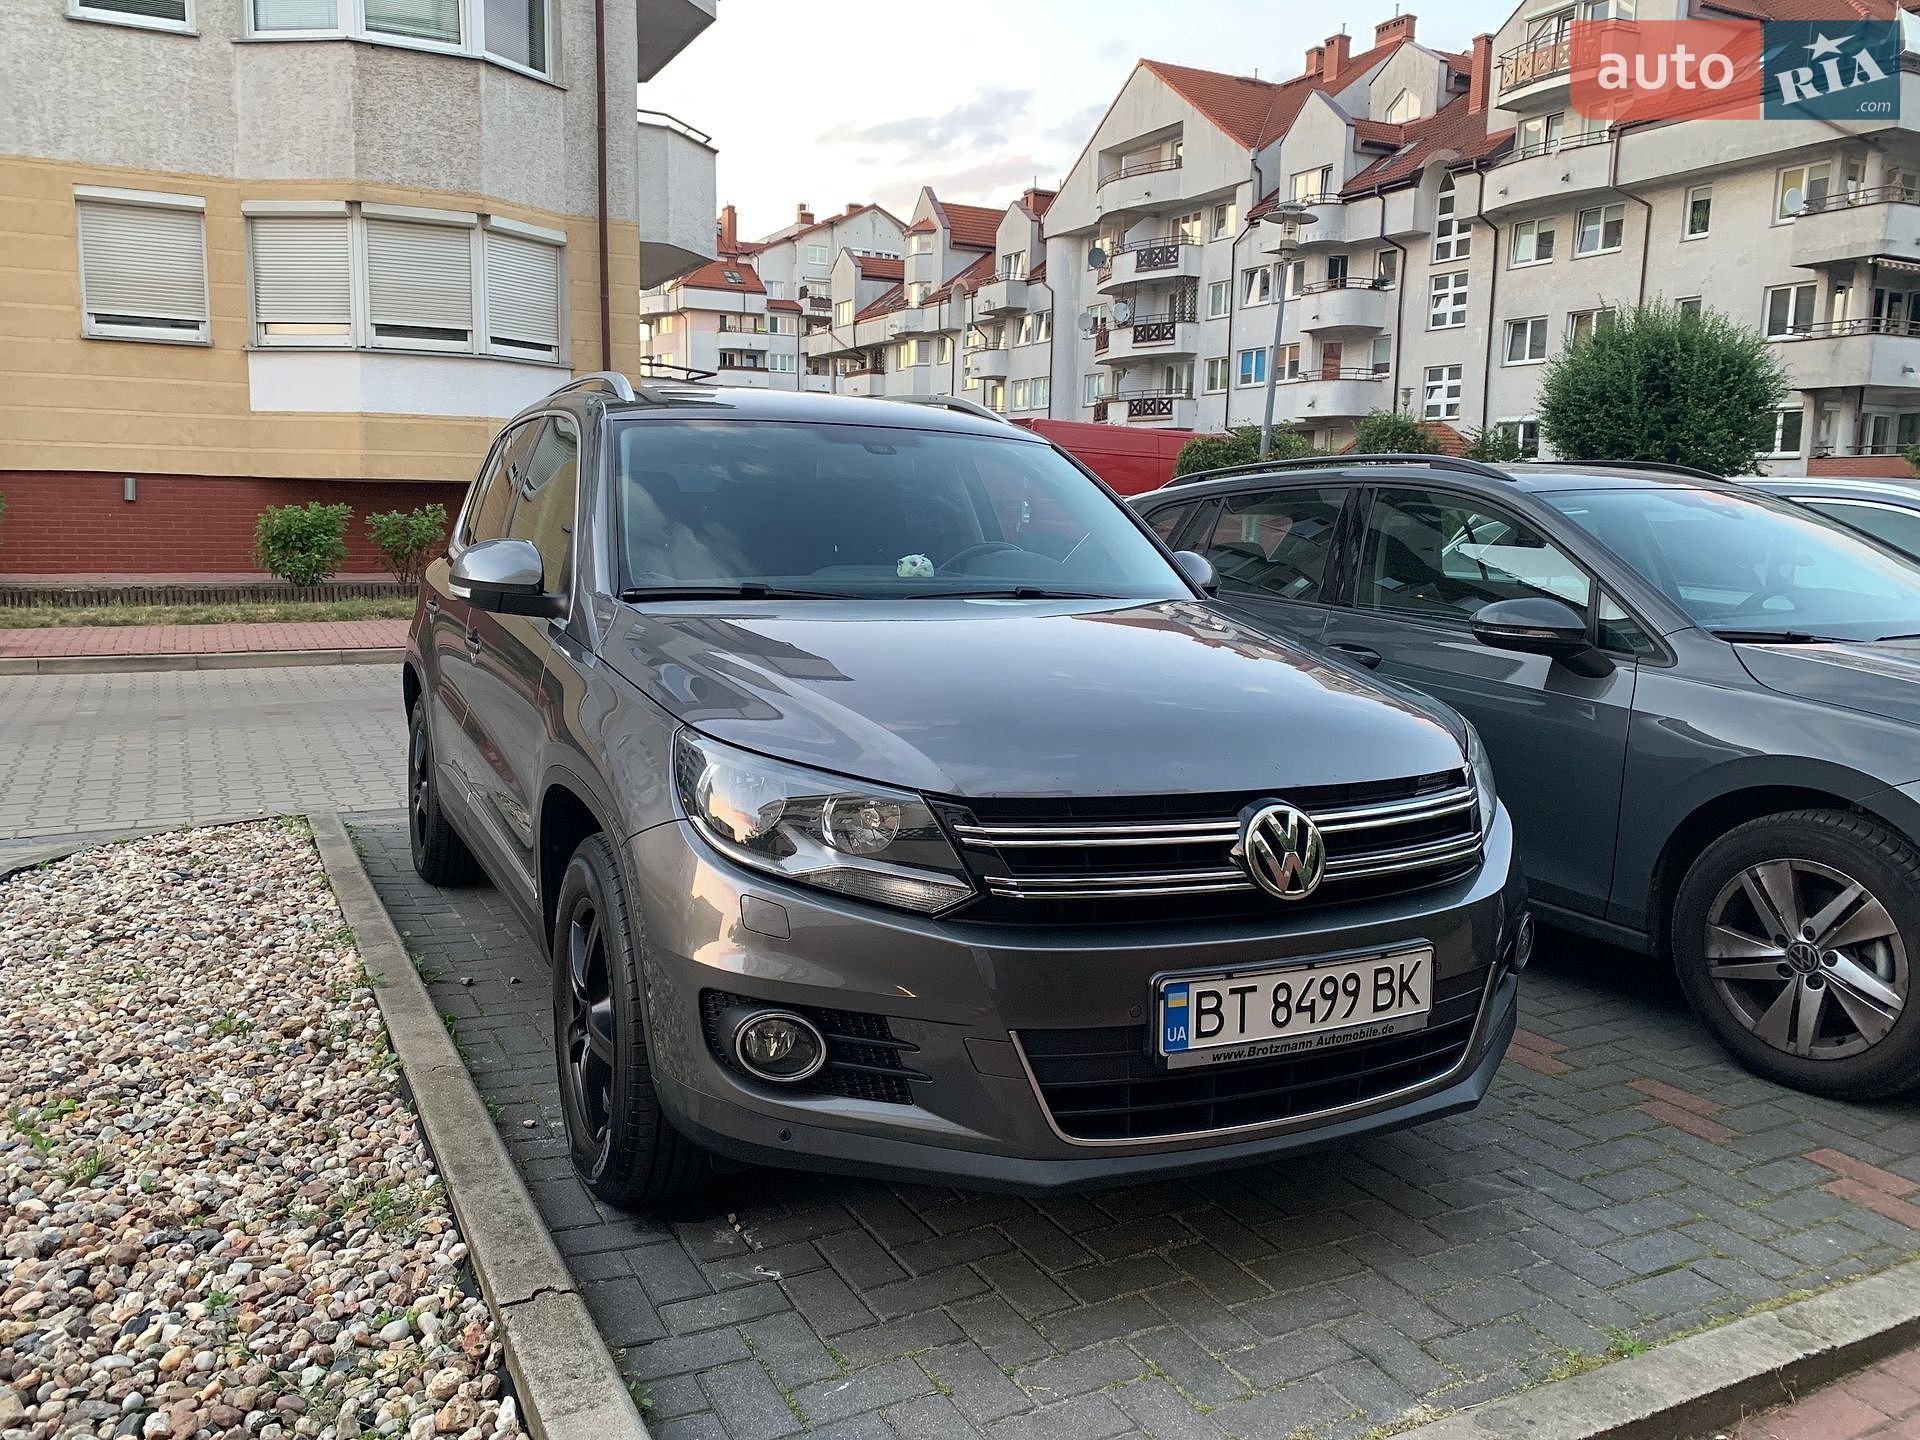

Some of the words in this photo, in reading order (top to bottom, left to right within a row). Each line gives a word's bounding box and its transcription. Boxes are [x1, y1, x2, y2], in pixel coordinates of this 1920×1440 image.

[1245, 805, 1326, 900] VW
[1194, 985, 1257, 1039] BT
[1271, 972, 1361, 1028] 8499
[1372, 959, 1423, 1013] BK
[1167, 1026, 1187, 1042] UA
[1211, 1039, 1313, 1062] www.Brotzmann
[1316, 1024, 1394, 1047] Automobile.de
